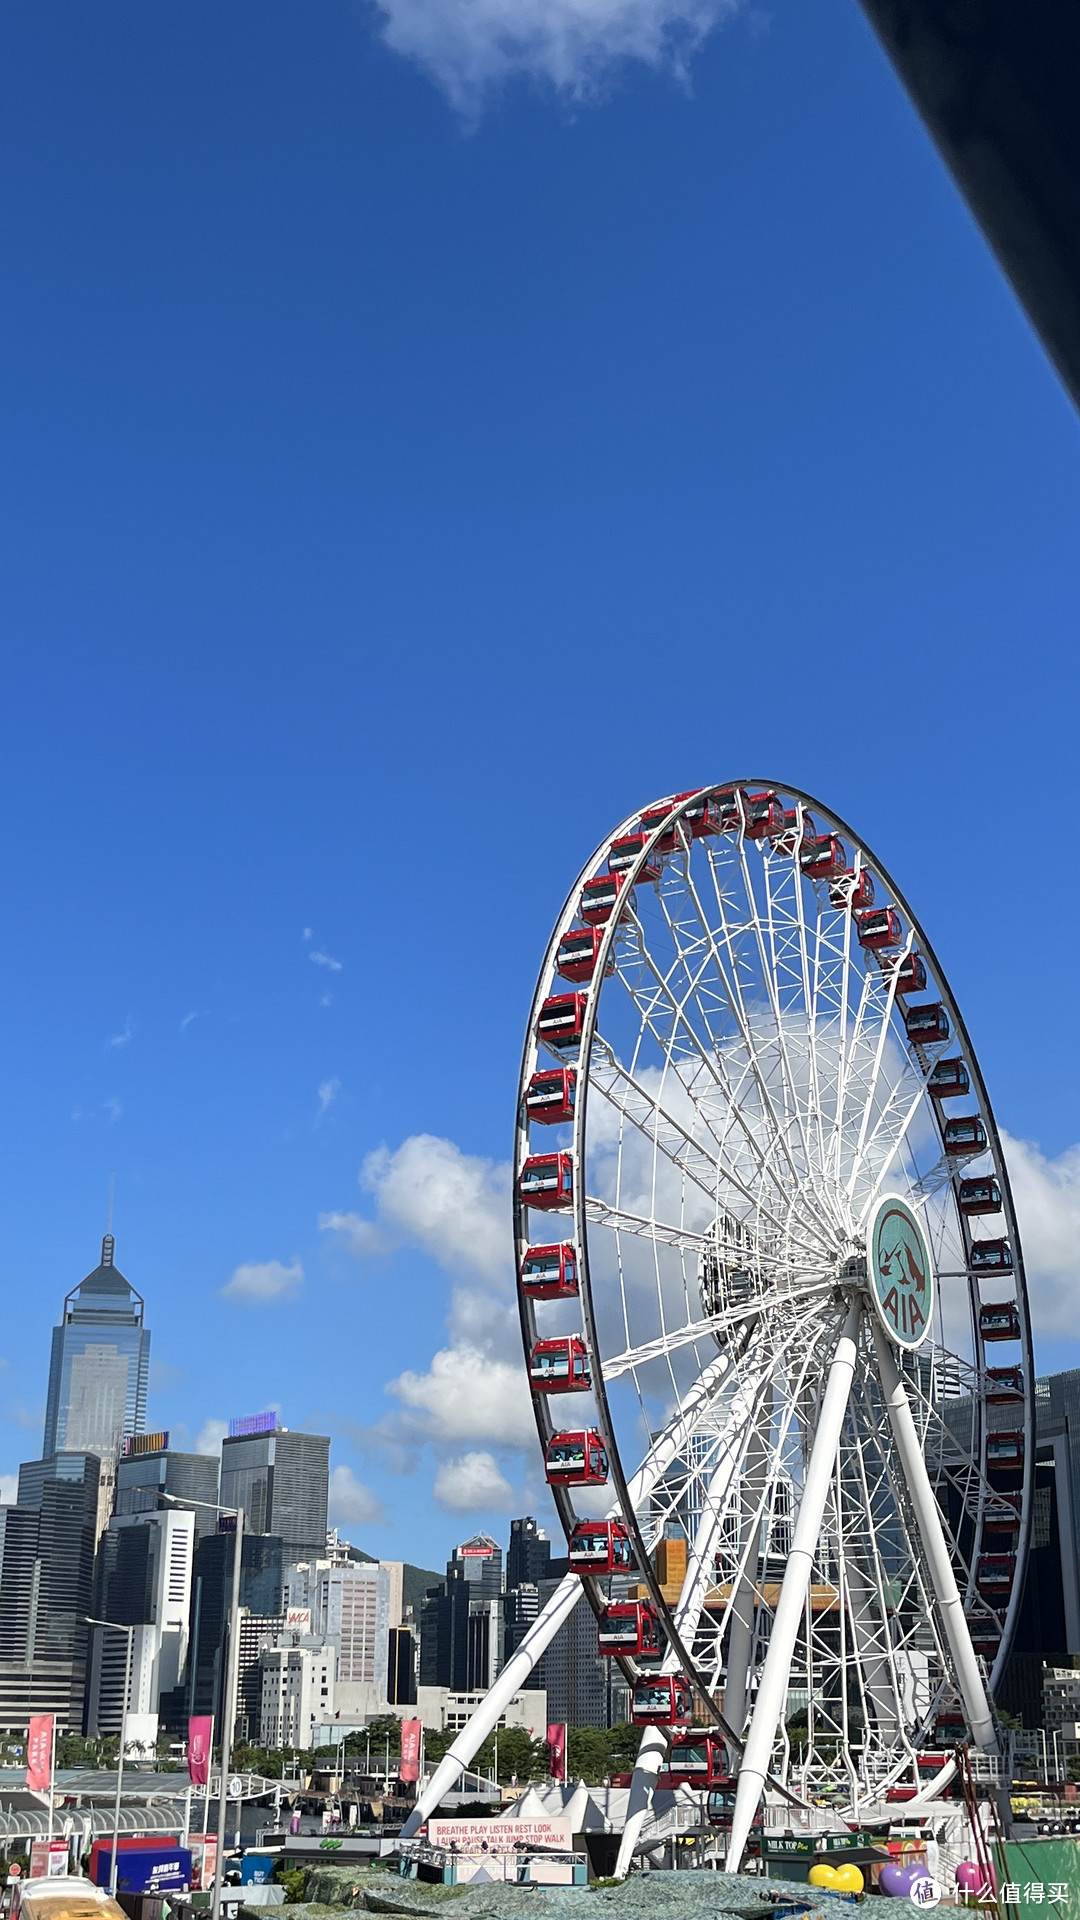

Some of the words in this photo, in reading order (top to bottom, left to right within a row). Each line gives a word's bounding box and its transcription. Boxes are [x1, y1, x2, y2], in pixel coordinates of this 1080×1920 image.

[882, 1286, 926, 1336] AIA
[232, 1782, 240, 1793] 10
[437, 1826, 468, 1835] BREATHE
[471, 1825, 488, 1834] PLAY
[490, 1825, 513, 1834] LISTEN
[515, 1825, 532, 1833] REST
[534, 1824, 551, 1833] LOOK
[437, 1837, 460, 1845] LAUGH
[487, 1835, 503, 1843] TALK
[506, 1835, 524, 1843] JUMP
[525, 1834, 543, 1843] STOP
[544, 1834, 565, 1843] WALK
[767, 1840, 783, 1849] MILK
[784, 1840, 797, 1850] TOP
[253, 1870, 265, 1878] BUY
